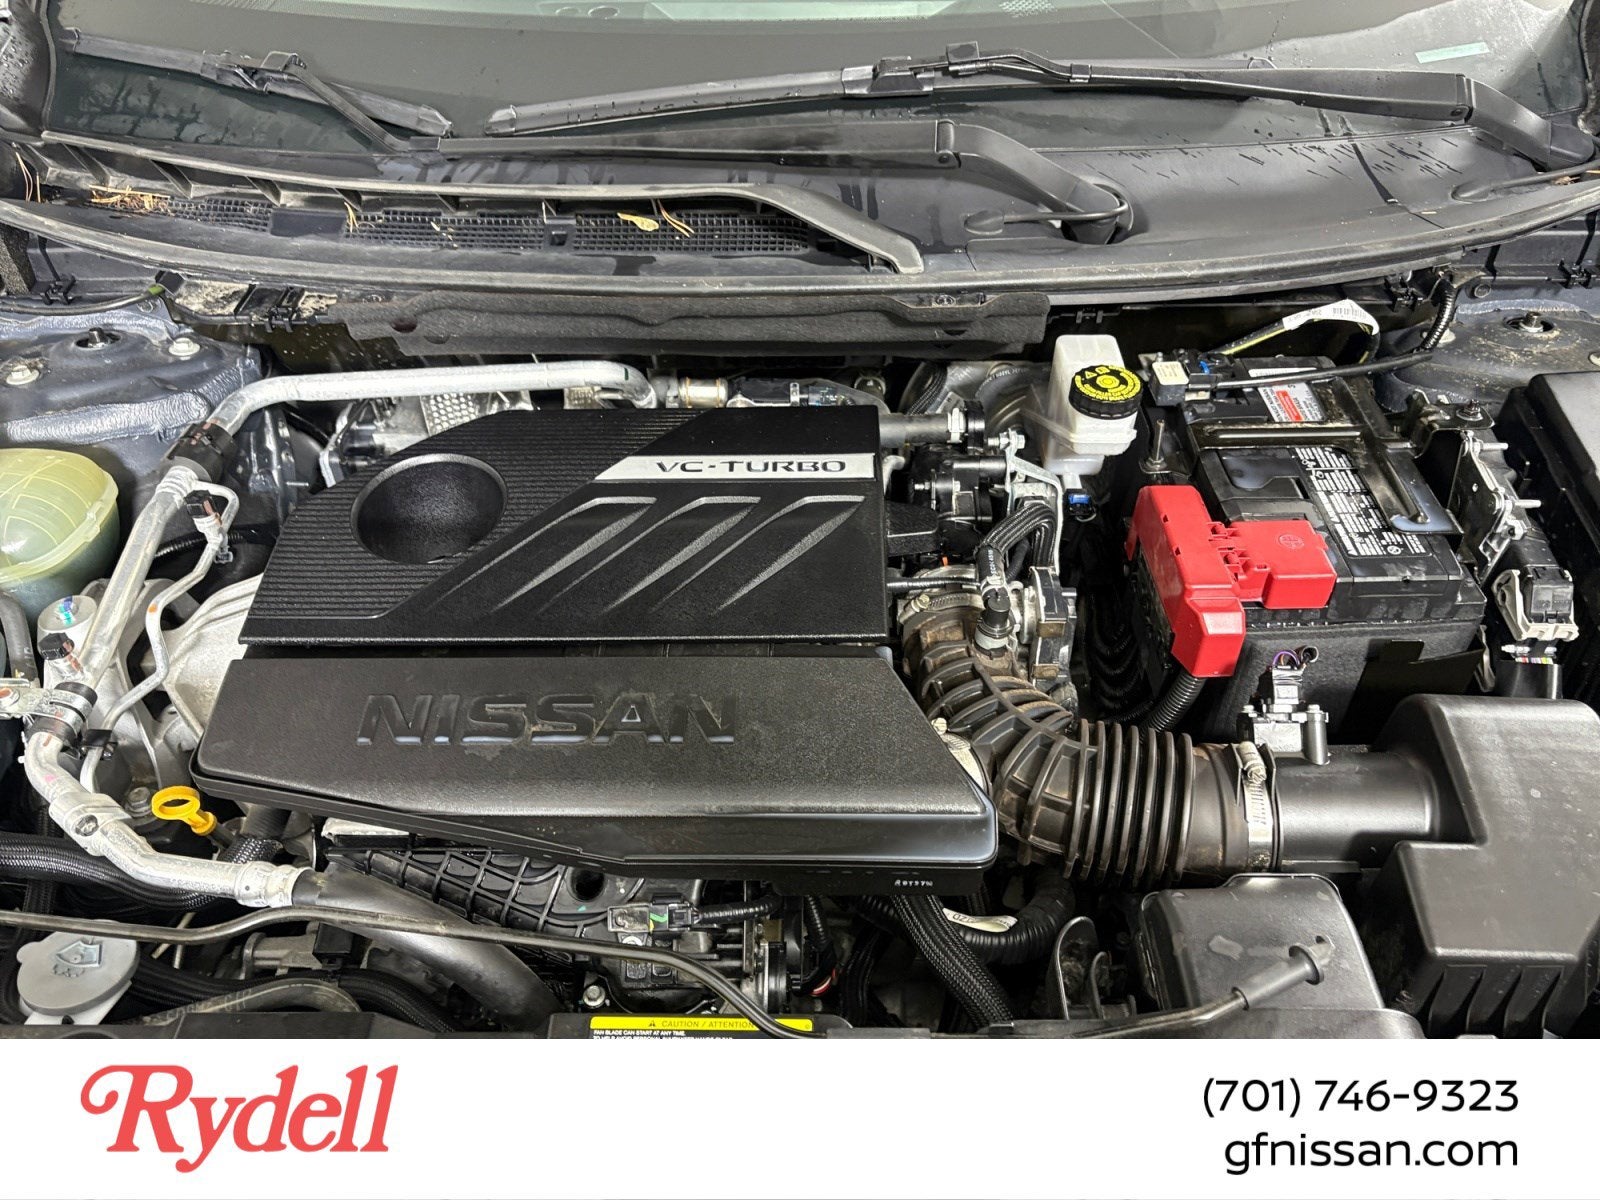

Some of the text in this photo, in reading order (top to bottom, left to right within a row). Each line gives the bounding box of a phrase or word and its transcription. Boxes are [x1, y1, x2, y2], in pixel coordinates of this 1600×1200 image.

[656, 460, 846, 473] VC-TURBO
[356, 694, 736, 746] NISSAN
[661, 1020, 699, 1028] CAUTION
[708, 1020, 754, 1028] ATTENTION
